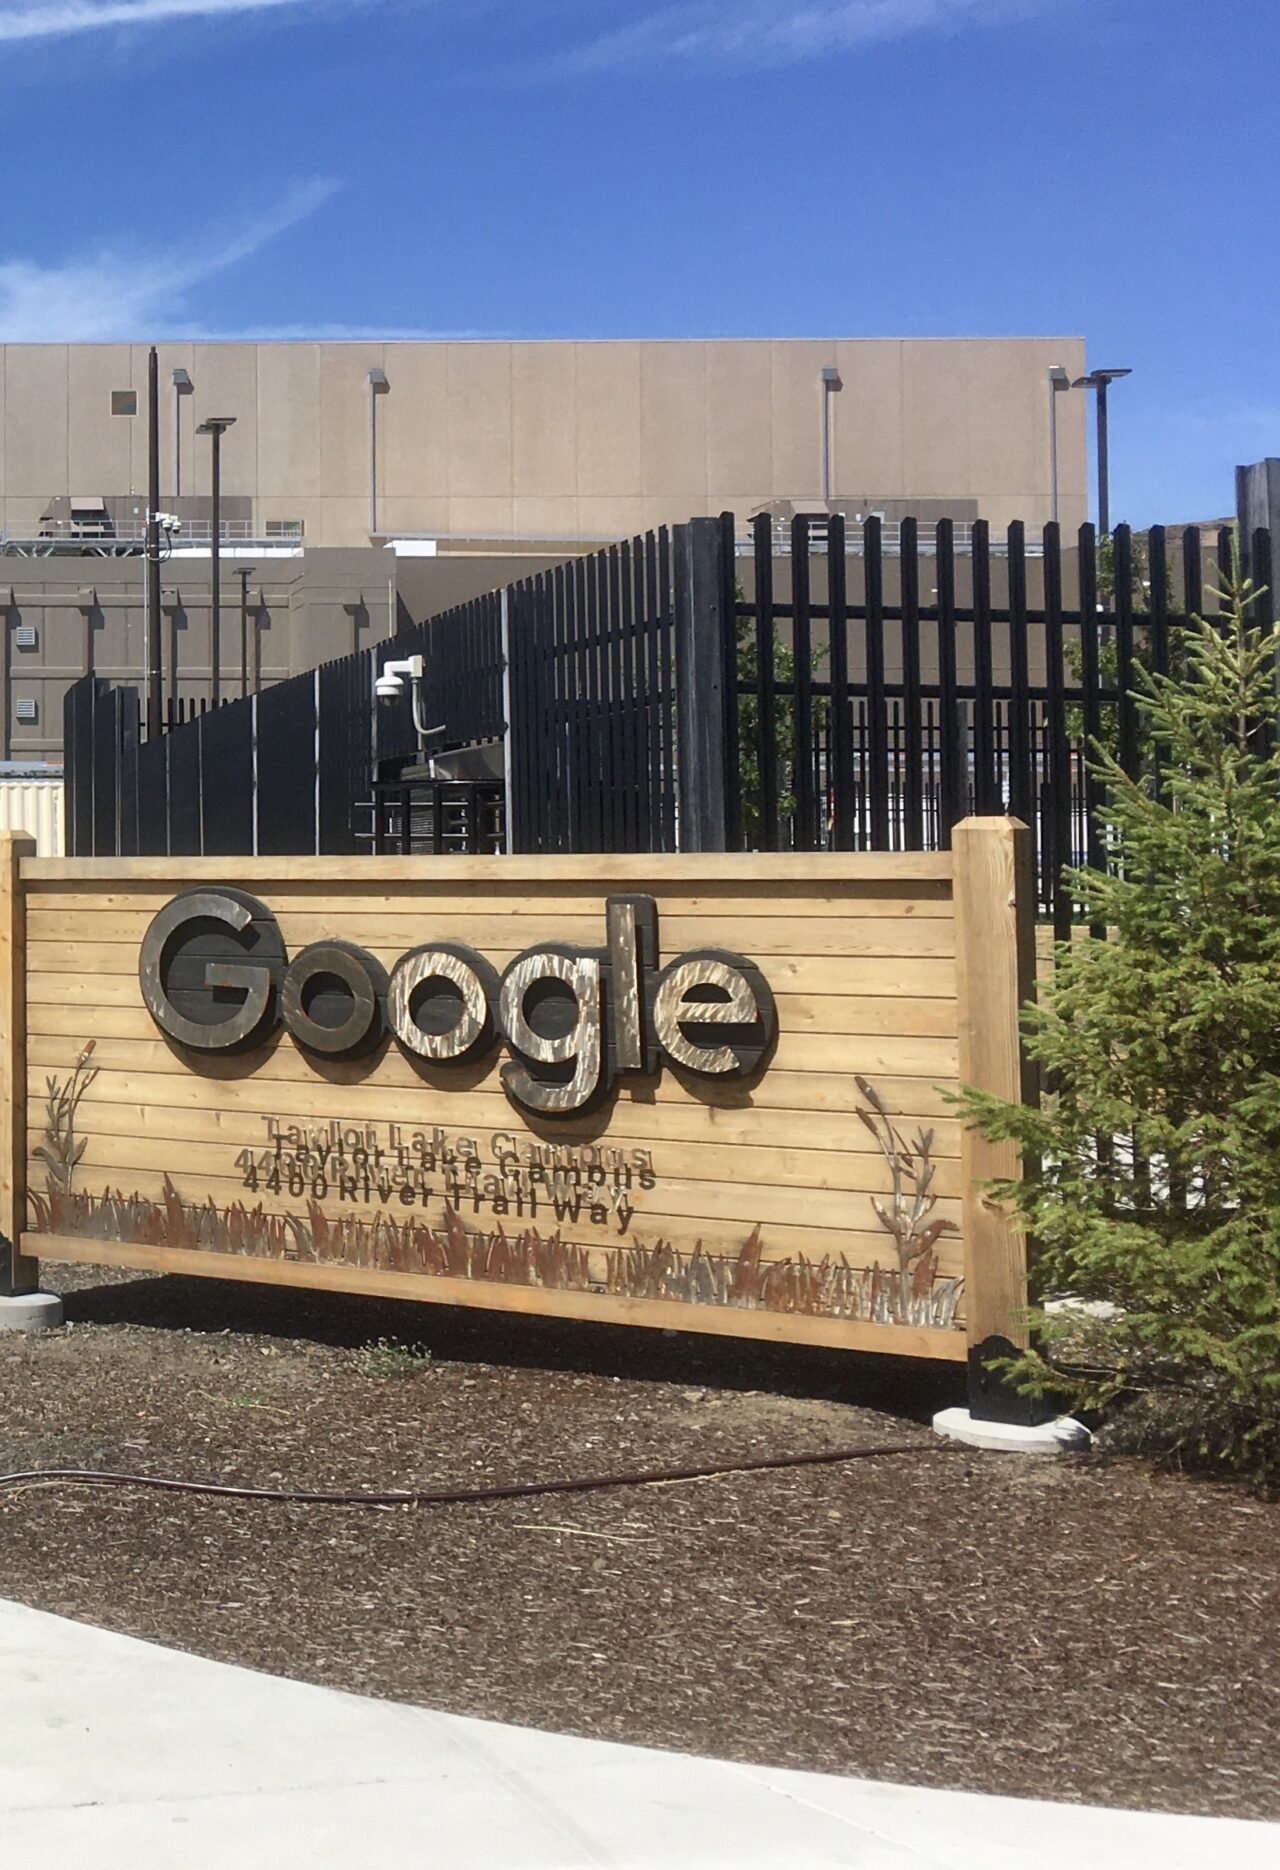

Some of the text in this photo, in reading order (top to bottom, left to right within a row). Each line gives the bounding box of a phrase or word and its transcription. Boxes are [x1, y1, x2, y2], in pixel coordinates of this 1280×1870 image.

[139, 888, 768, 1113] Google
[261, 1115, 649, 1172] Taylor Lake Campus
[234, 1148, 627, 1214] 4400 River Trail Way
